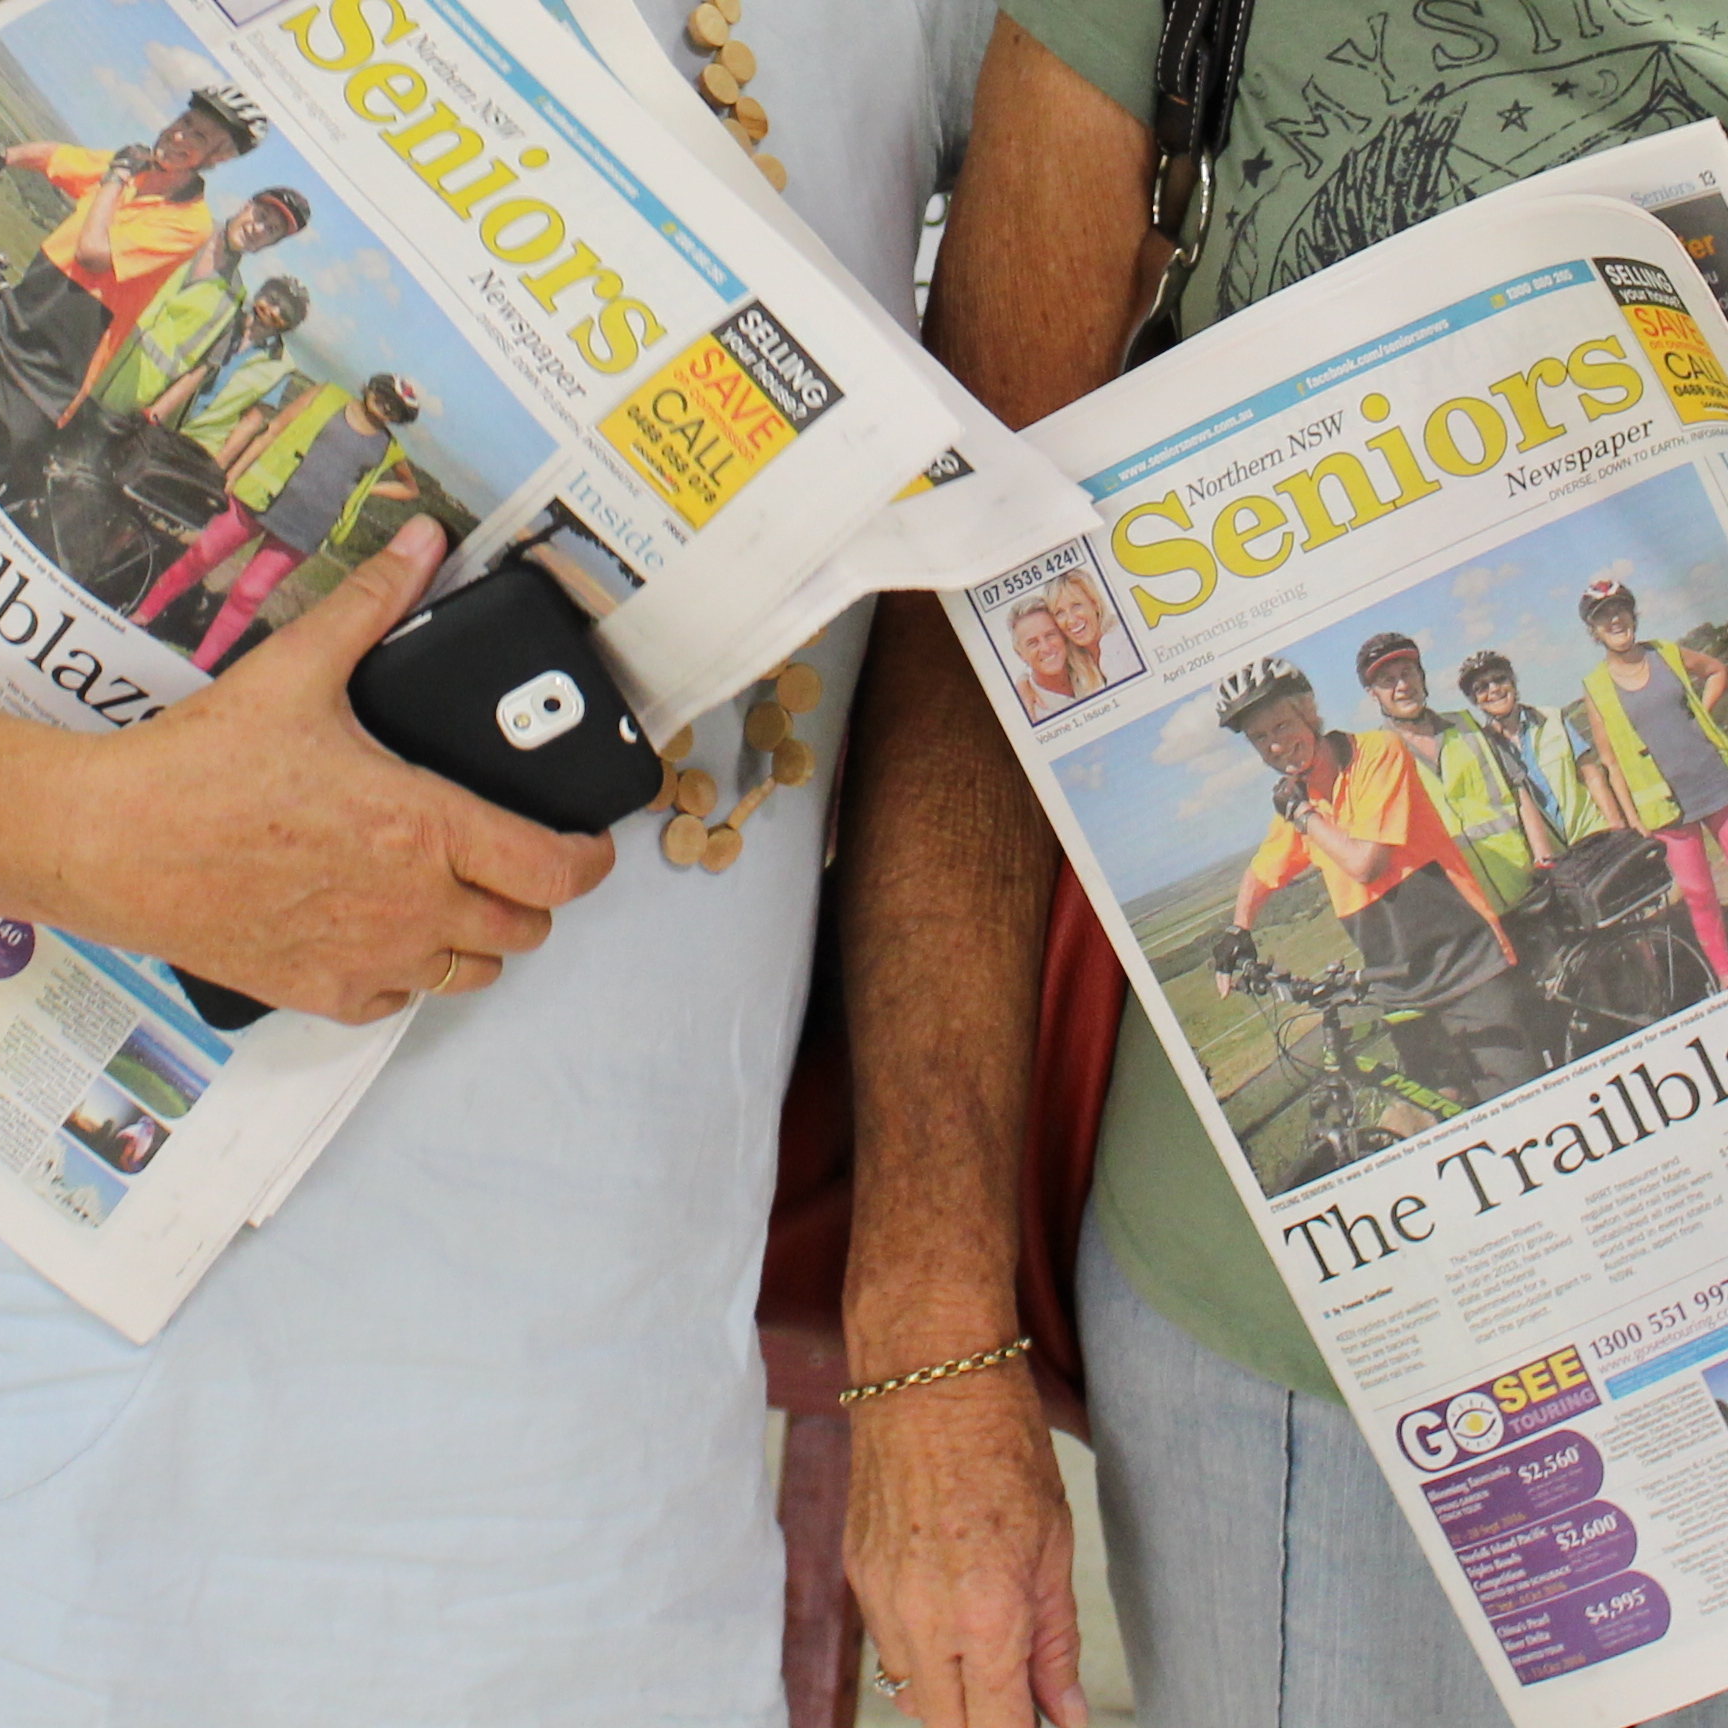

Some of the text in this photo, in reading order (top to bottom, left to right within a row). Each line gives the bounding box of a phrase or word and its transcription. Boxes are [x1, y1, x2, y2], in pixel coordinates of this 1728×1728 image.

[1697, 168, 1717, 188] 13
[1603, 262, 1674, 293] SELLING
[465, 266, 590, 400] Newspaper
[718, 326, 758, 366] your
[736, 308, 830, 410] SELLING
[686, 345, 789, 452] SAVE
[1116, 406, 1255, 482] www.seniorsnews.com.au
[1305, 317, 1450, 389] facebook.com/seniorsnews
[648, 386, 738, 488] CALL
[1183, 409, 1346, 507] Northern NSW
[1503, 416, 1655, 499] Newspaper
[1115, 334, 1642, 631] Seniors
[1548, 472, 1598, 502] DIVERSE,
[1596, 456, 1632, 480] DOWN
[1632, 448, 1649, 464] TO
[566, 468, 666, 571] Inside
[981, 545, 1079, 605] 07 5536 4241
[1152, 580, 1309, 665] Embracing ageing
[1161, 650, 1216, 684] April 2016
[1035, 721, 1072, 745] Volume
[1081, 702, 1112, 723] Issue
[1415, 1137, 1432, 1149] the
[1431, 1120, 1470, 1143] morning
[1469, 1111, 1488, 1124] ride
[1499, 1086, 1541, 1111] Northern
[1541, 1073, 1570, 1091] Rivers
[1570, 1060, 1598, 1078] riders
[1598, 1044, 1631, 1067] geared
[1631, 1039, 1644, 1051] up
[1643, 1031, 1658, 1044] for
[1659, 1023, 1678, 1036] new
[1678, 1010, 1705, 1027] roads
[1281, 1187, 1436, 1285] The
[1588, 1321, 1643, 1360] 1300
[1646, 1300, 1688, 1335] 551
[1491, 1346, 1588, 1414] SEE
[1508, 1385, 1597, 1434] TOURING
[1516, 1444, 1580, 1485] $2,560
[1554, 1512, 1618, 1552] $2,600
[1584, 1585, 1646, 1625] $4,995
